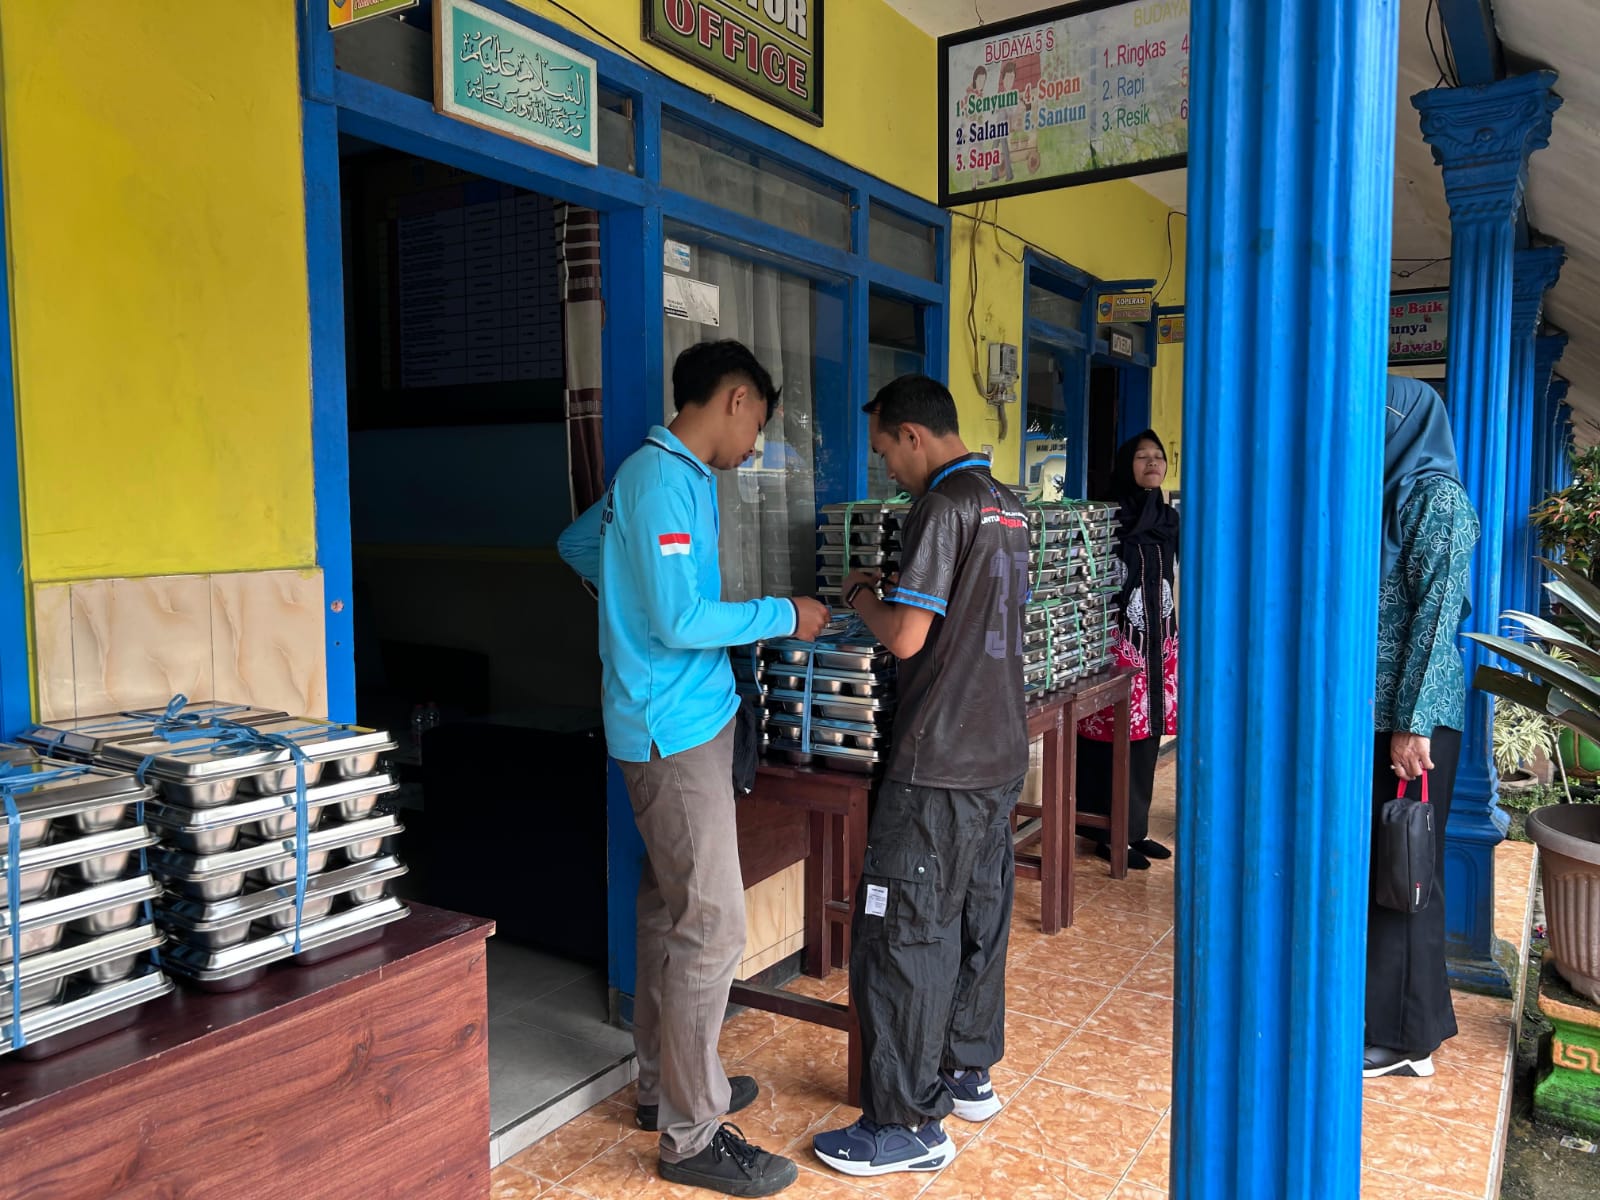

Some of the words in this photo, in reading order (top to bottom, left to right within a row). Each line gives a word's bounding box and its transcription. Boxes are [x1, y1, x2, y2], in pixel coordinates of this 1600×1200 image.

[1133, 3, 1188, 28] BUDAYA
[664, 0, 807, 99] OFFICE
[985, 35, 1033, 63] BUDAYA
[1035, 33, 1042, 52] 5
[1046, 29, 1055, 49] S
[1103, 48, 1114, 69] 1.
[1117, 39, 1167, 67] Ringkas
[1024, 86, 1035, 103] 4.
[1038, 77, 1080, 100] Sopan
[1102, 80, 1113, 100] 2.
[1117, 72, 1145, 99] Rapi
[956, 101, 965, 117] 1.
[968, 90, 1018, 115] Senyum
[1024, 112, 1035, 131] 5.
[1038, 104, 1087, 128] Santun
[1102, 111, 1113, 132] 3.
[1117, 103, 1150, 128] Resik
[956, 128, 966, 145] 2.
[969, 121, 1009, 143] Salam
[956, 154, 966, 171] 3.
[969, 149, 1000, 170] Sapa
[1116, 297, 1146, 306] KOPERASI
[1408, 301, 1443, 314] Baik
[1390, 324, 1427, 336] unya
[1392, 340, 1442, 353] Jawab
